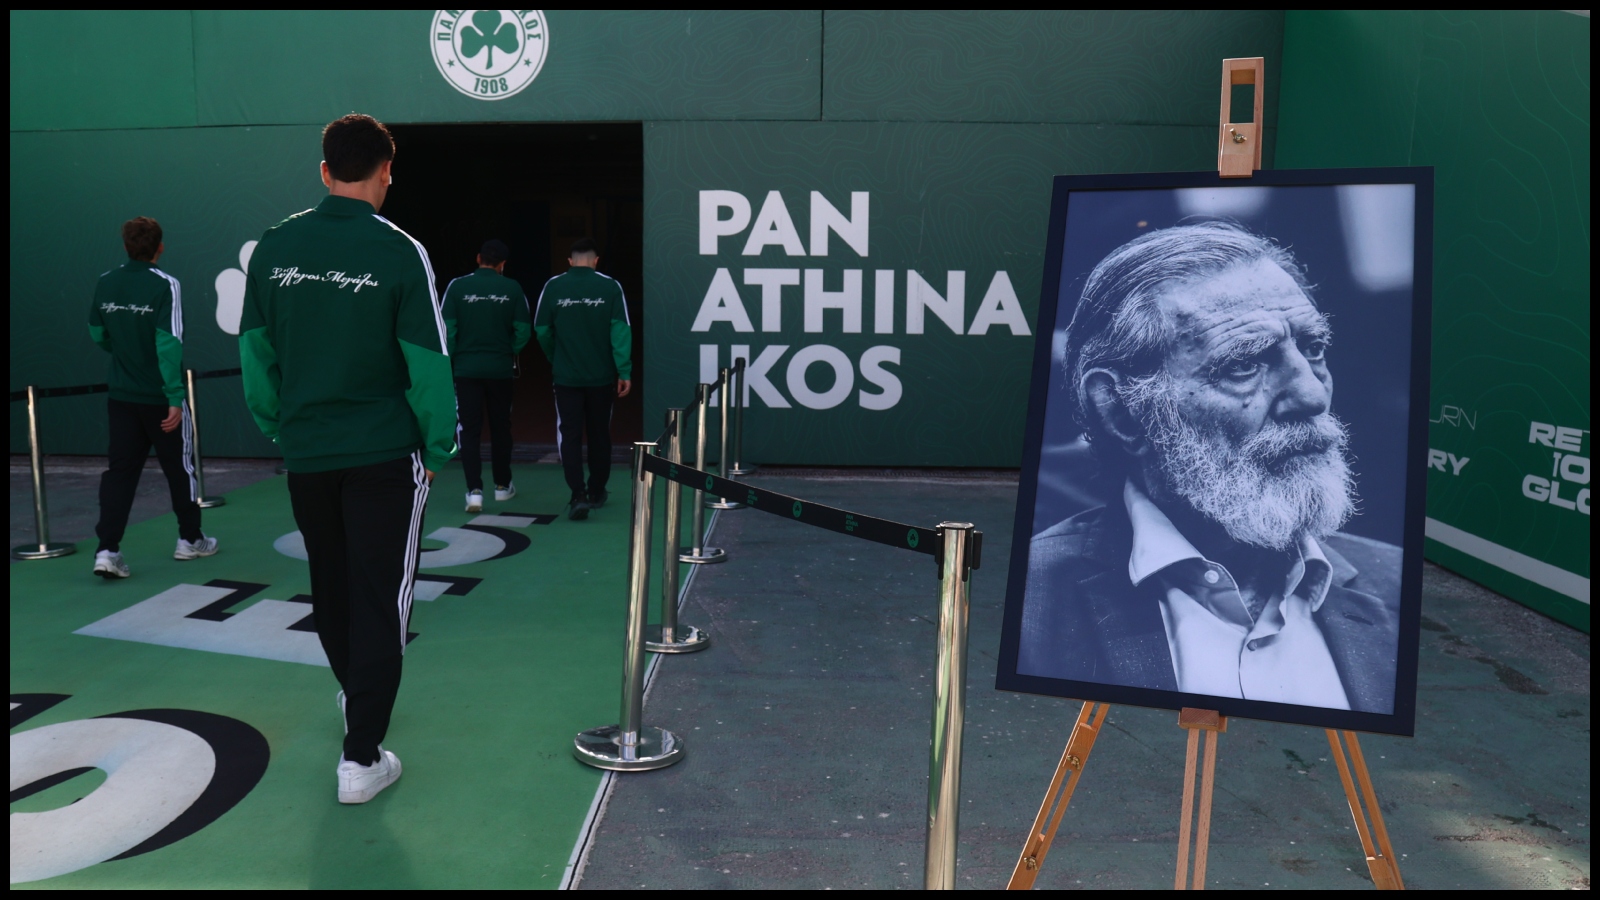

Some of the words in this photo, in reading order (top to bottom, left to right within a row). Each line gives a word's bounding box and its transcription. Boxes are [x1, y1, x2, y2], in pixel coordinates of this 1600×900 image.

[474, 77, 509, 94] 1908
[699, 190, 869, 257] PAN
[690, 268, 1032, 336] ATHINA
[699, 344, 903, 411] IKOS
[1528, 421, 1590, 452] RE
[1427, 448, 1470, 476] RY
[1552, 452, 1590, 484] TO
